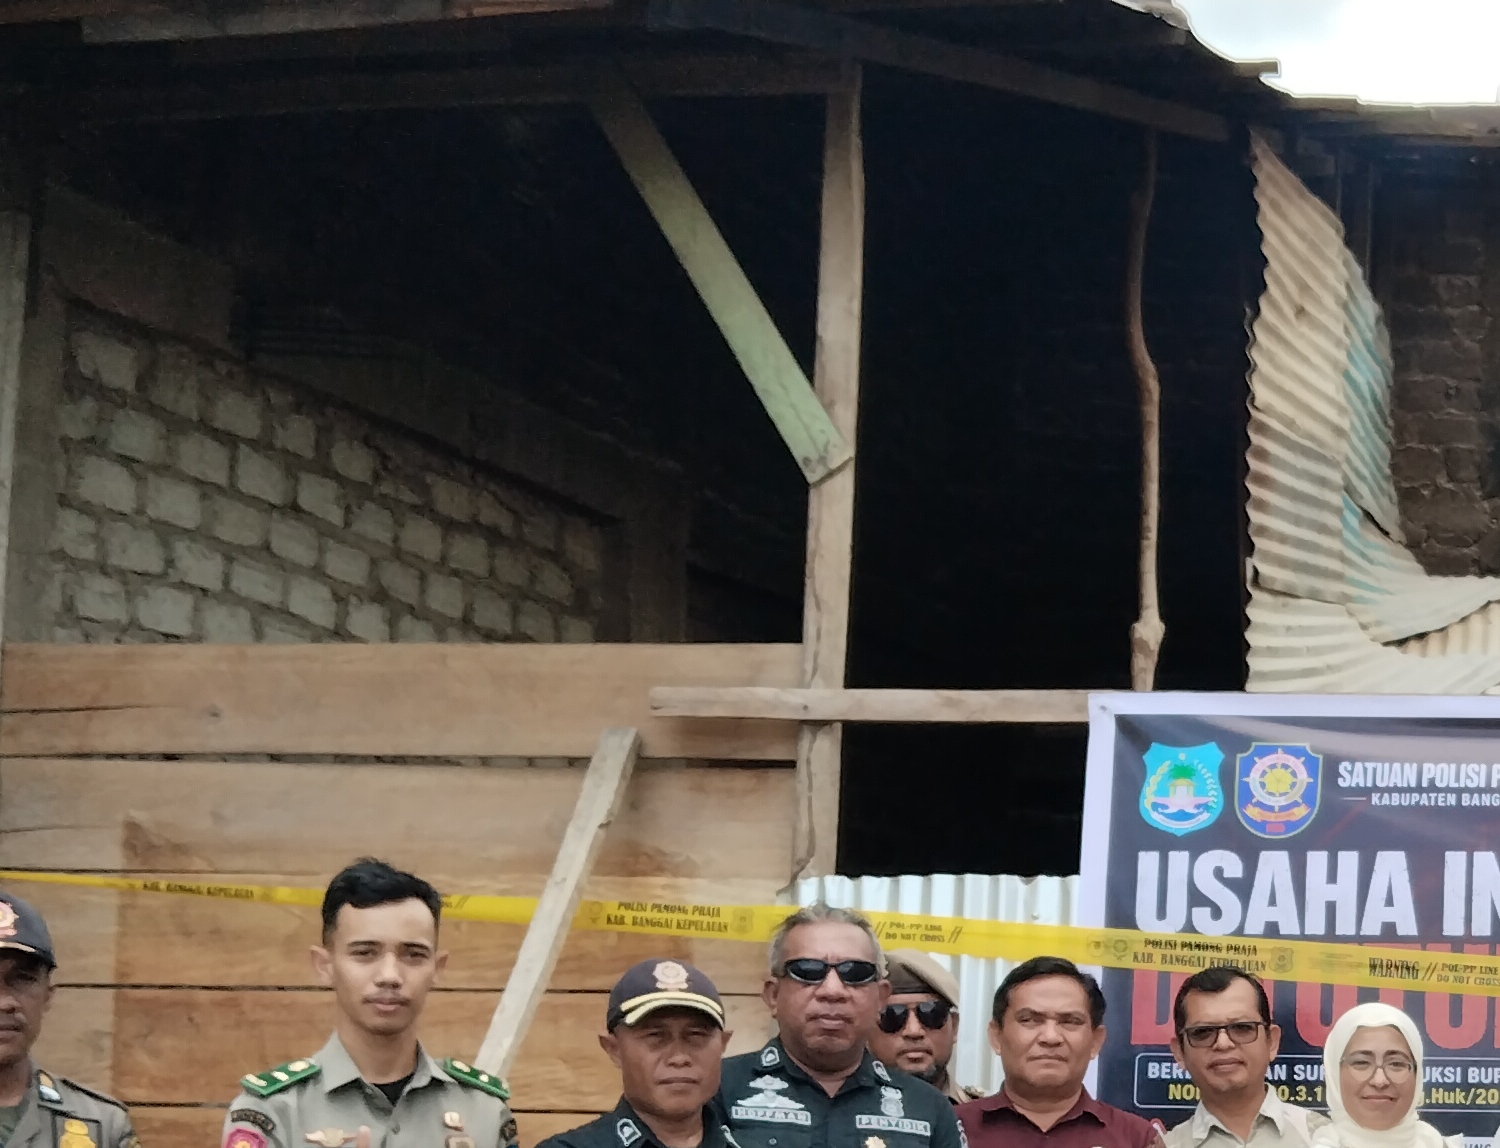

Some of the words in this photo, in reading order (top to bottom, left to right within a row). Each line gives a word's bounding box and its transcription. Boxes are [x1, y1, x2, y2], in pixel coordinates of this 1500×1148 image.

[1337, 761, 1418, 788] SATUAN
[1422, 762, 1487, 788] POLISI
[1371, 792, 1456, 807] KABUPATEN
[1135, 850, 1419, 936] USAHA
[617, 901, 648, 912] POLISI
[691, 905, 721, 918] PRAJA
[606, 913, 628, 926] KAB.
[631, 915, 674, 930] BANGGAI
[675, 918, 729, 933] KEPULAUAN
[1144, 937, 1177, 951] POLISI
[1180, 939, 1223, 954] PAMONG
[1226, 943, 1258, 957] PRAJA
[1132, 951, 1156, 964] KAB.
[1160, 953, 1206, 968] BANGGAI
[1368, 957, 1420, 980] WARNING
[1479, 965, 1499, 976] LINE
[1436, 973, 1450, 983] DO
[1452, 975, 1470, 985] NOT
[858, 1116, 929, 1133] PENYIDIK
